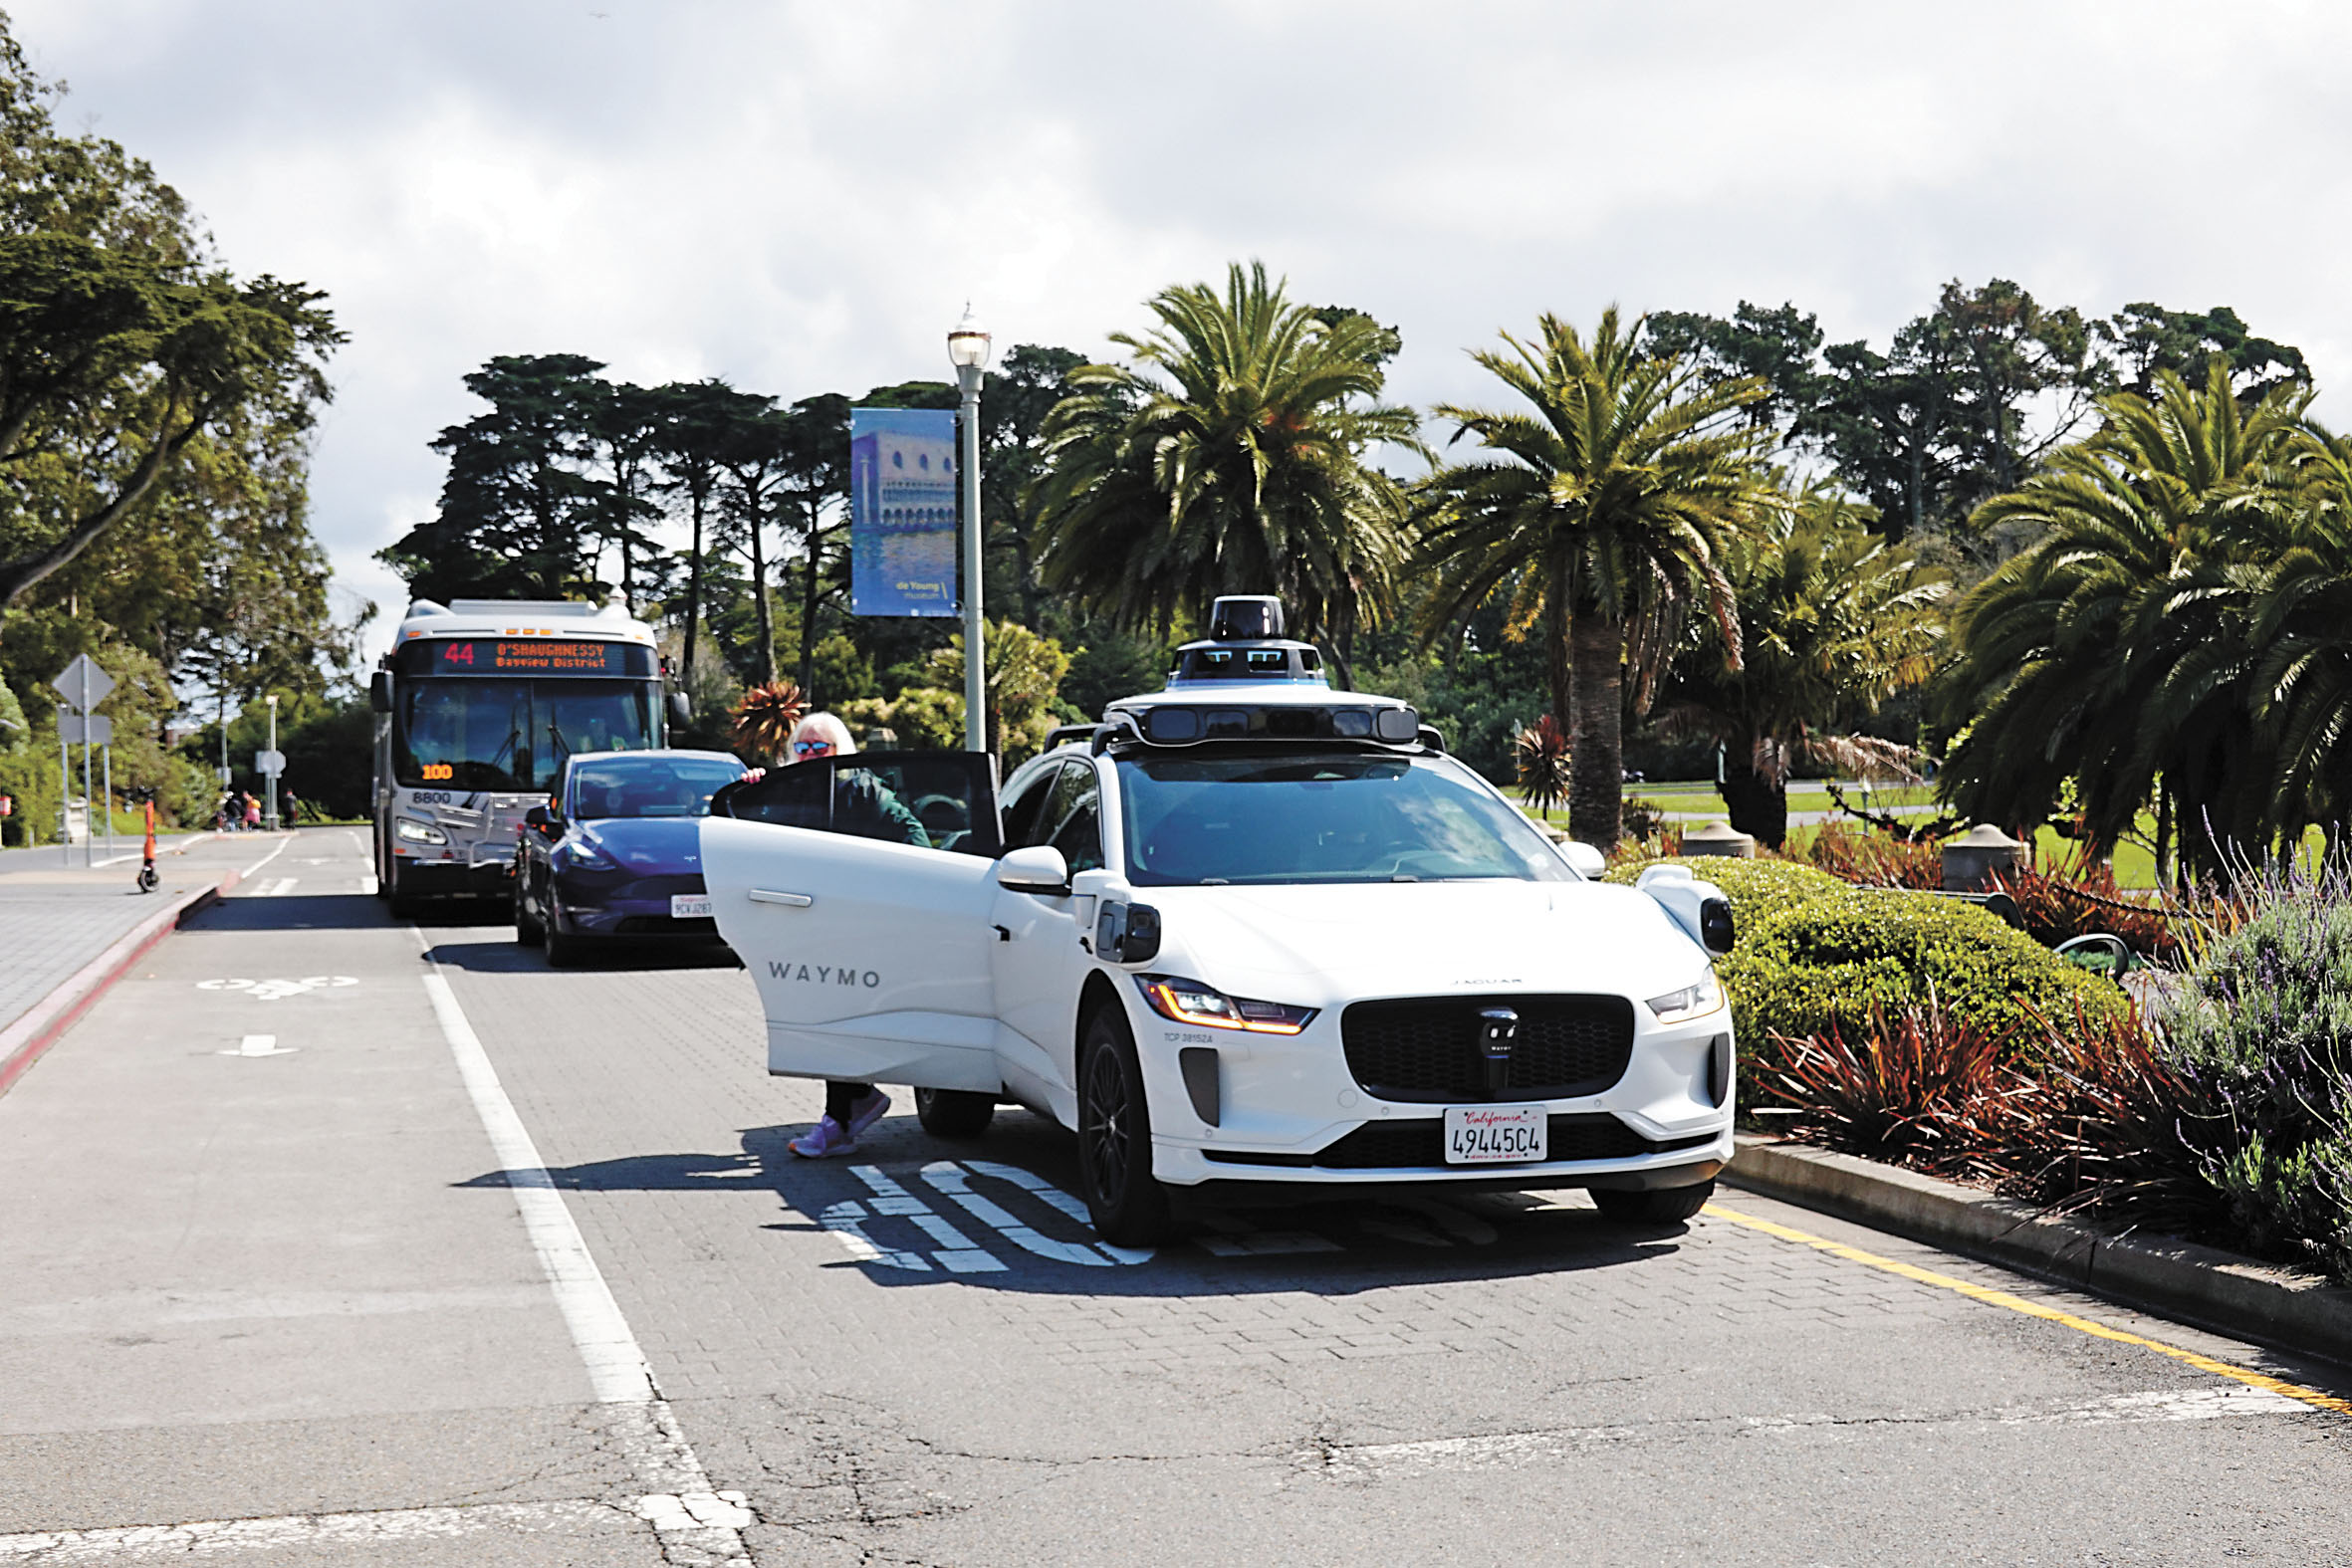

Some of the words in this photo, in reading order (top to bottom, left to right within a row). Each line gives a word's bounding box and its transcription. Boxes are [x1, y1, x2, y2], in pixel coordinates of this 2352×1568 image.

[444, 643, 474, 665] 44
[497, 643, 604, 657] O'SHAUGHNESSY
[422, 764, 453, 780] 100
[412, 791, 451, 803] 8800
[769, 961, 880, 989] WAYMO
[1466, 1111, 1522, 1128] California
[1453, 1127, 1540, 1155] 49445C4
